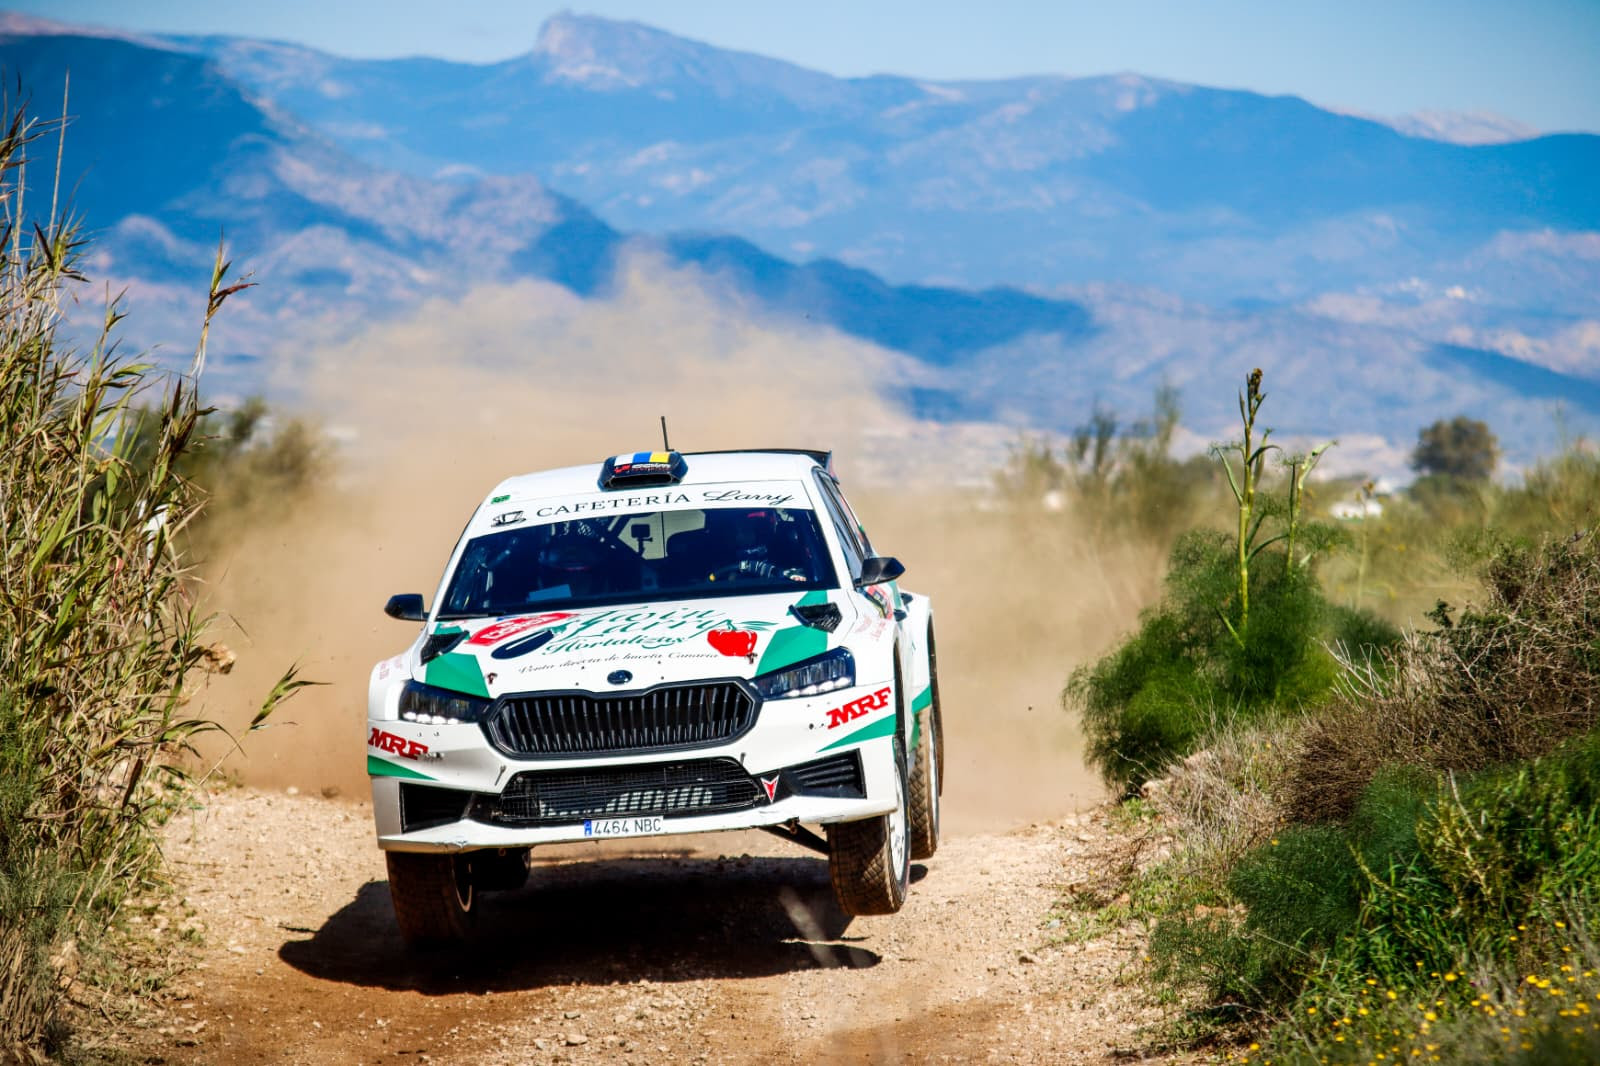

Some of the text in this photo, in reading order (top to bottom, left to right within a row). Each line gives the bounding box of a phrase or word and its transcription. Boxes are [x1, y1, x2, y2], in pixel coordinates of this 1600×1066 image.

[536, 492, 691, 518] CAFETERÍA
[702, 489, 795, 506] Larry
[604, 654, 619, 662] de
[622, 652, 662, 660] huerta
[825, 686, 892, 730] MRF
[367, 727, 430, 761] MRF
[594, 817, 662, 834] 4464 NBC
